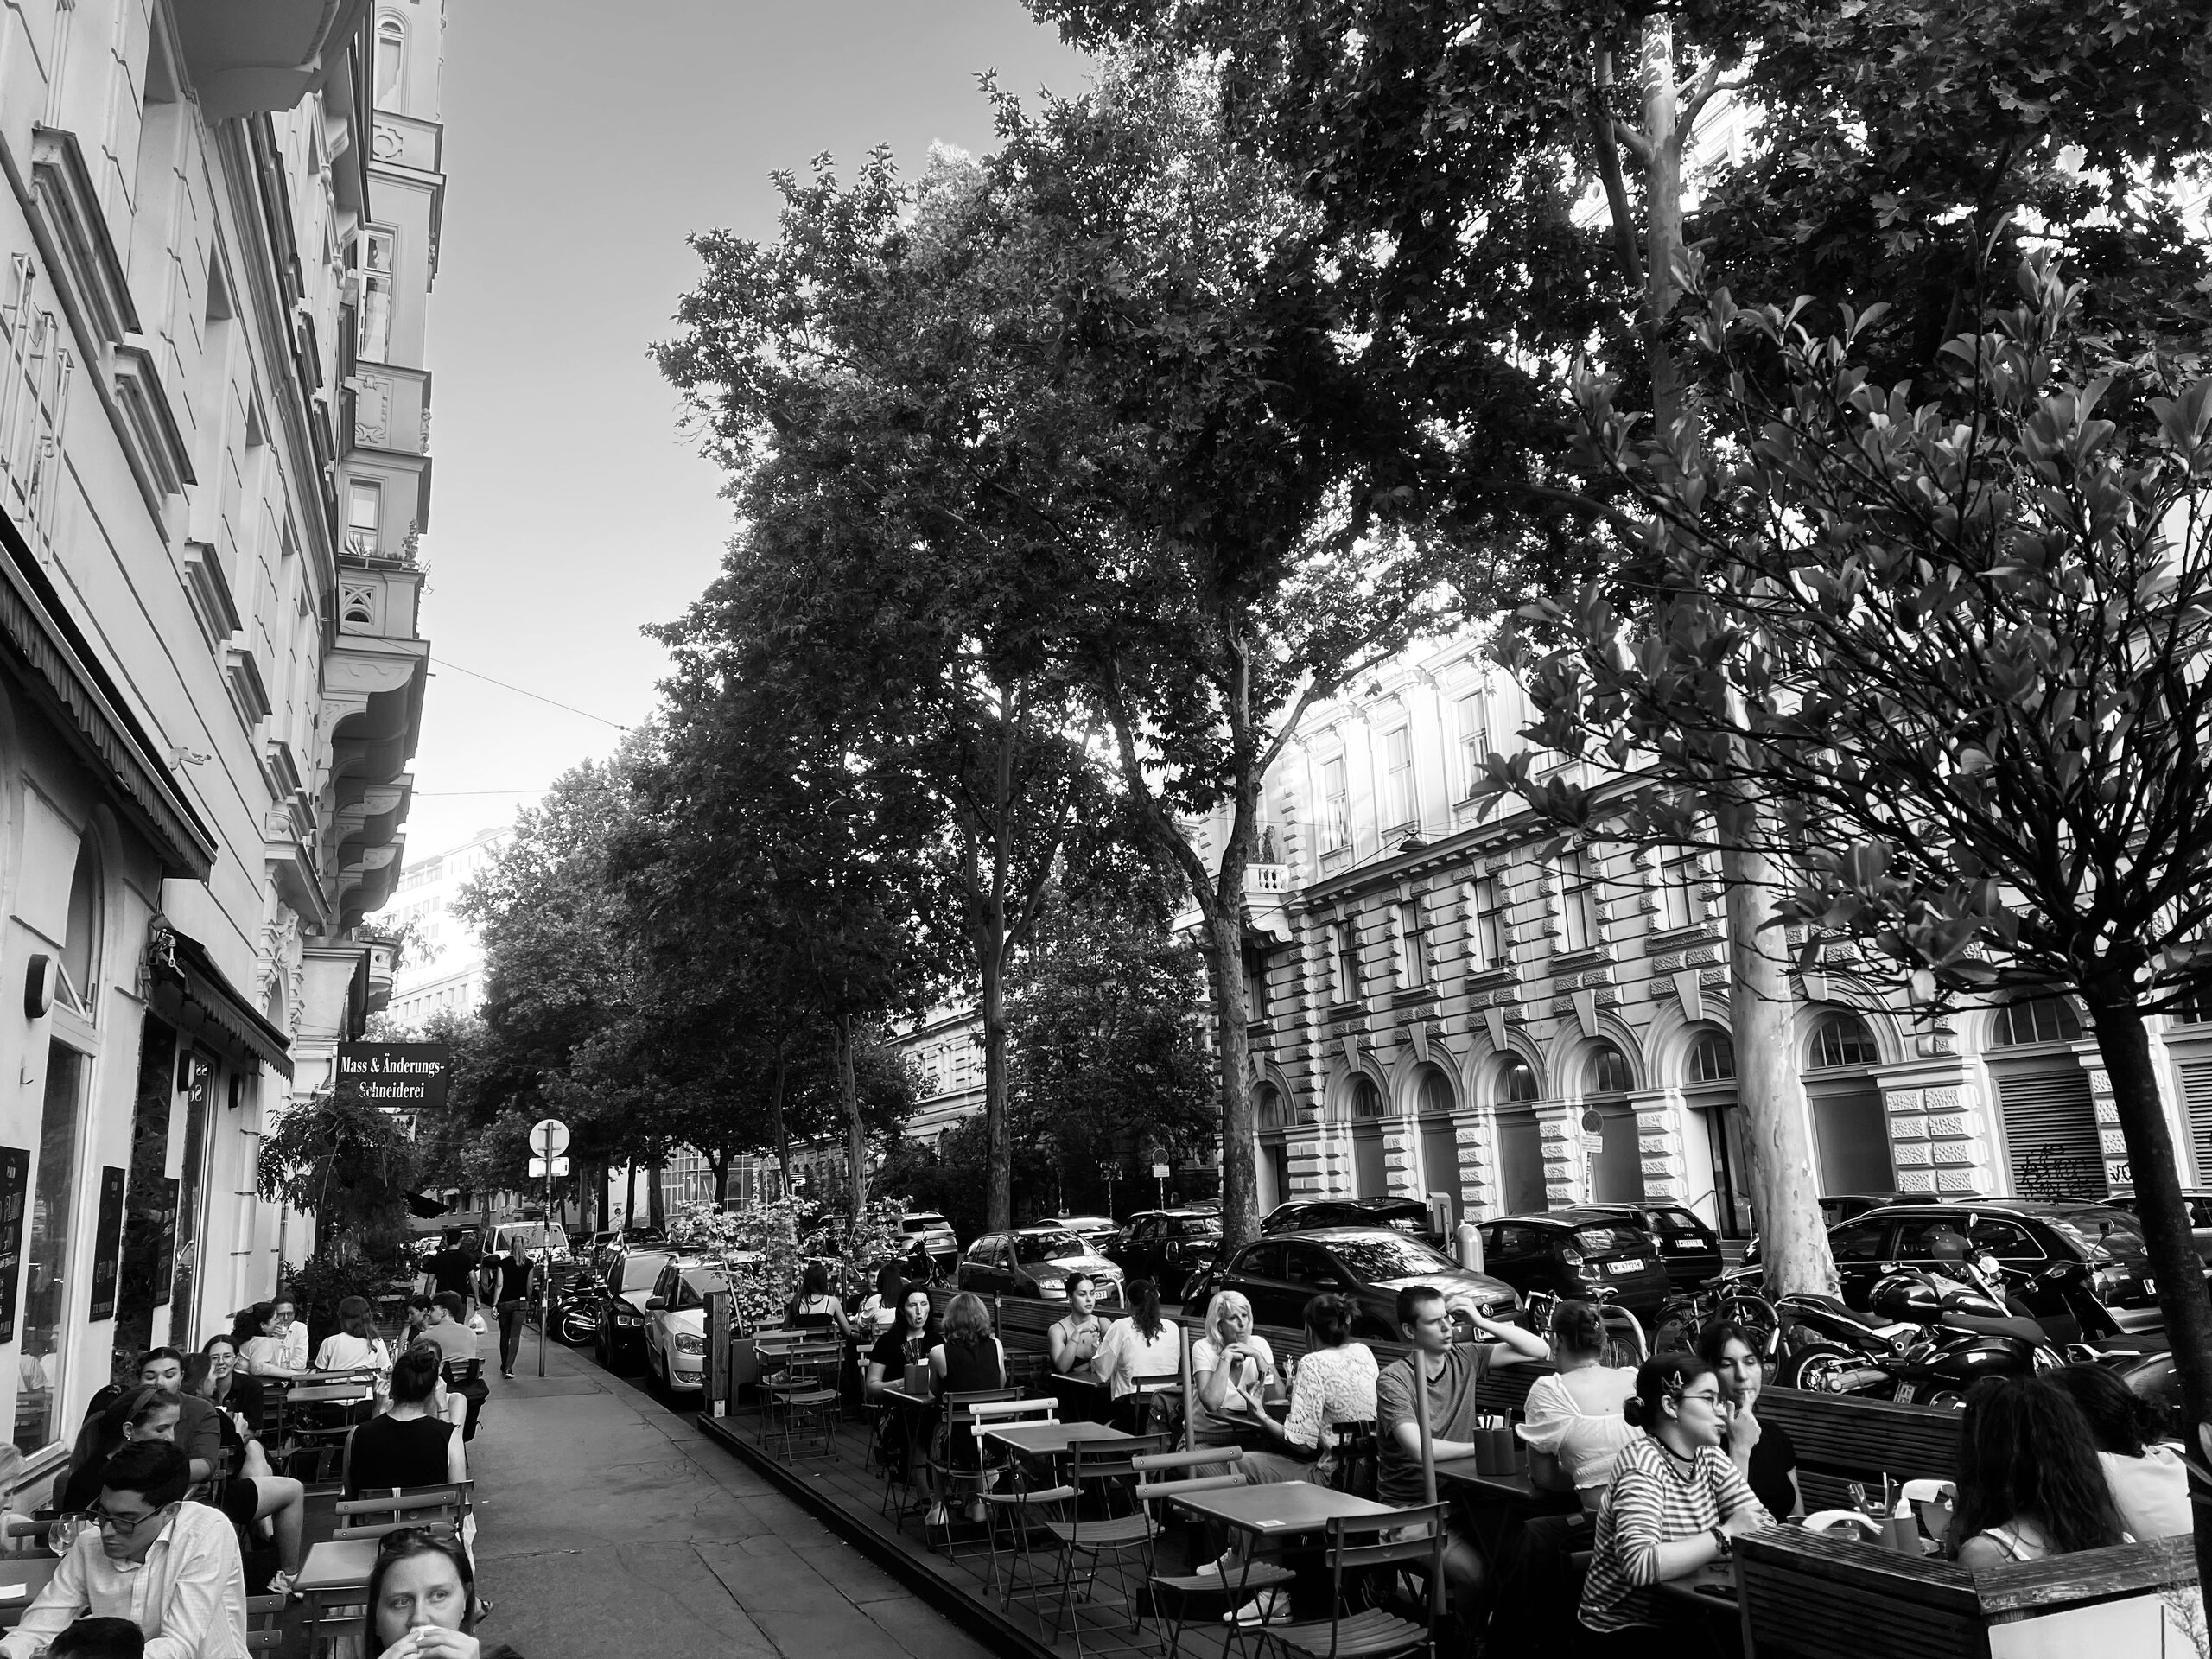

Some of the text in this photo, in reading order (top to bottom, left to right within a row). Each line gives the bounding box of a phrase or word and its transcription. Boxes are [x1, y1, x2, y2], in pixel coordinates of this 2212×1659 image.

[340, 1053, 445, 1078] Mass & Änderungs-
[359, 1081, 425, 1099] Schneiderei
